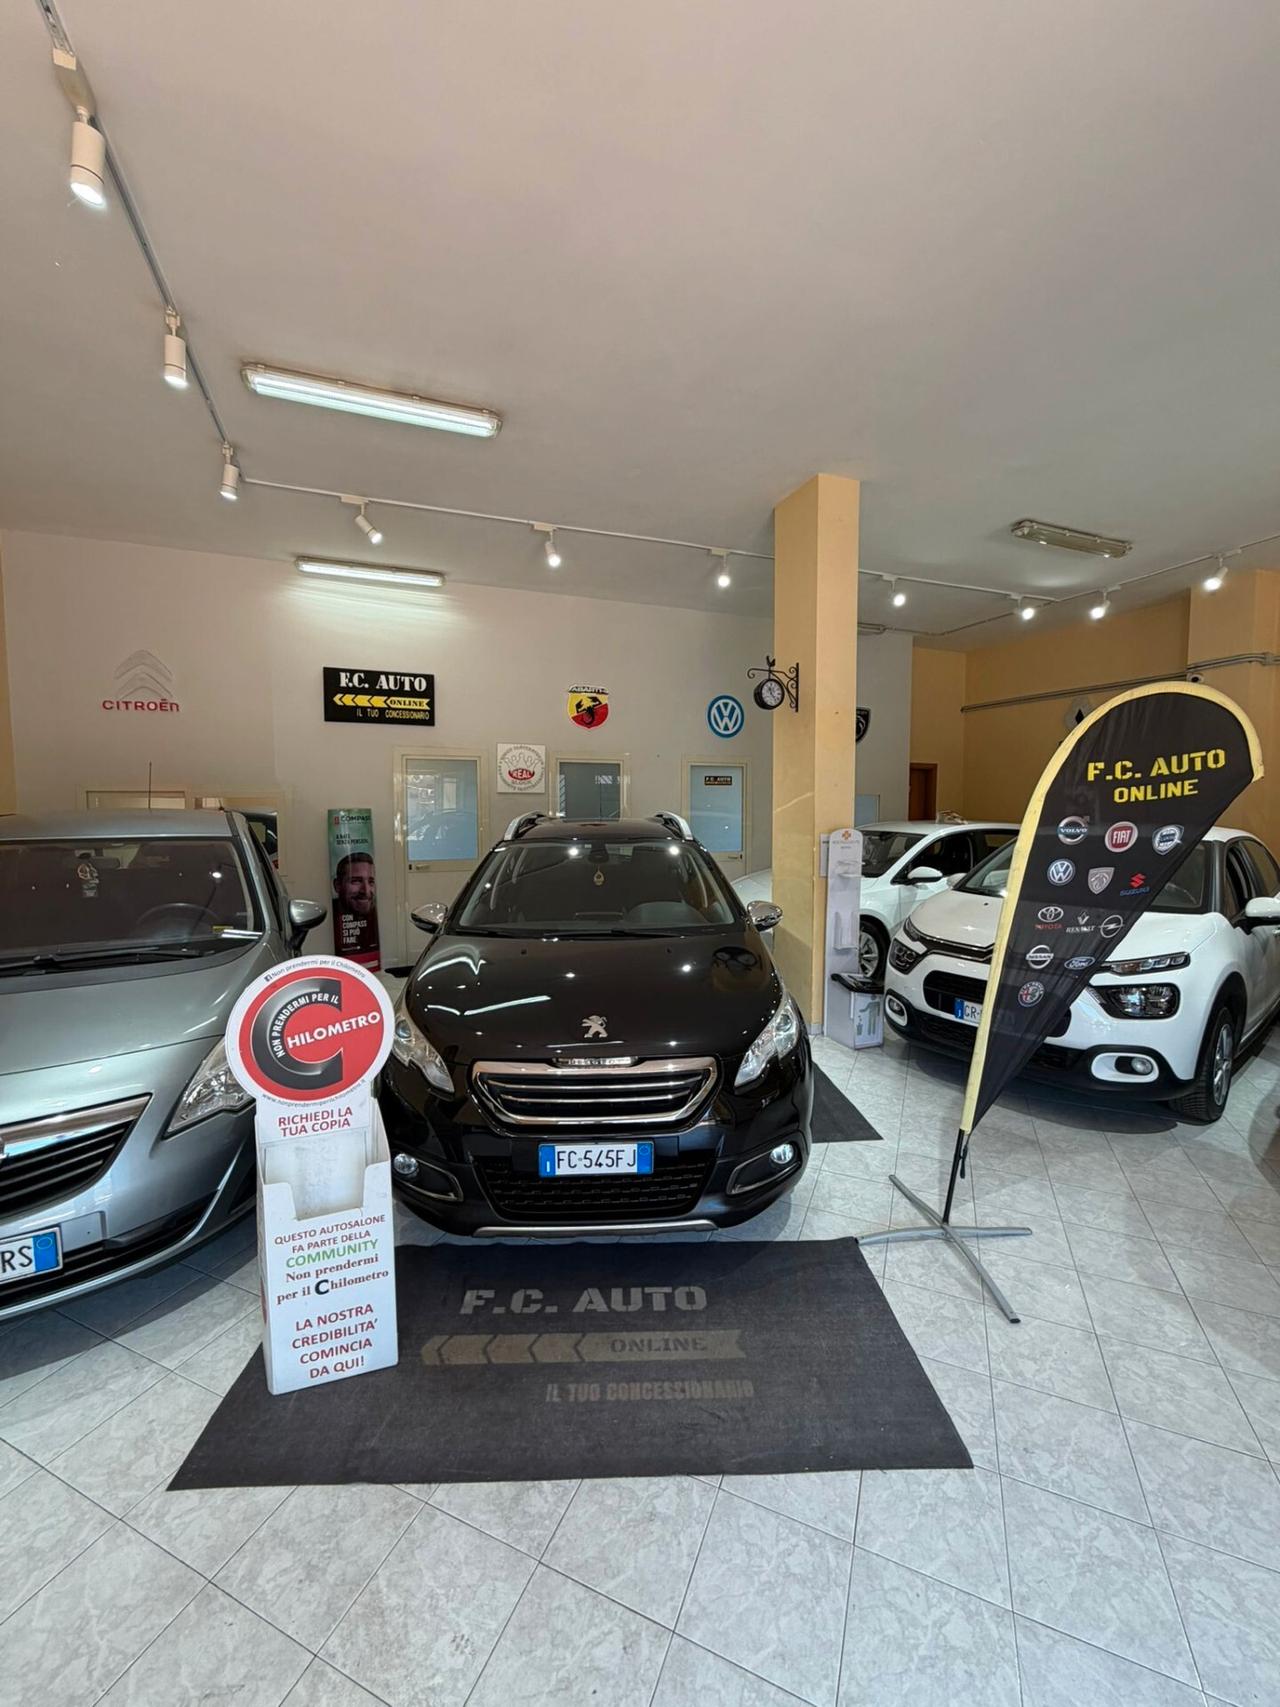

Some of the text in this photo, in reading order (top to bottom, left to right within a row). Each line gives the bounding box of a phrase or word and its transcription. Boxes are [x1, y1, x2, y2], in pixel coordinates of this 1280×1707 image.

[339, 671, 427, 692] F.C. AUTO
[356, 708, 430, 720] IL TUO CONCESSIONARIO
[389, 699, 425, 708] ONLINE
[1087, 748, 1226, 781] F.C. AUTO
[1113, 779, 1198, 803] ONLINE
[1112, 829, 1132, 844] FIAT
[285, 959, 319, 972] prendermi
[271, 993, 340, 1058] NON PRENDERMI PER IL
[278, 1106, 353, 1127] RICHIEDI LA
[281, 1118, 350, 1137] TUA COPIA
[274, 1215, 385, 1245] QUESTO AUTOSALONE
[292, 1230, 371, 1253] FA PARTE DELLA
[286, 1239, 379, 1268] COMMUNITY
[286, 1253, 379, 1283] Non prendermi
[276, 1291, 298, 1305] per
[302, 1285, 311, 1296] il
[460, 1286, 707, 1314] F.C. AUTO
[295, 1304, 374, 1331] LA NOSTRA
[300, 1338, 372, 1364] COMINCIA
[610, 1336, 707, 1354] ONLINE
[310, 1356, 364, 1378] DA QUI!
[546, 1379, 755, 1402] IL TUO CONCESSIONARIO
